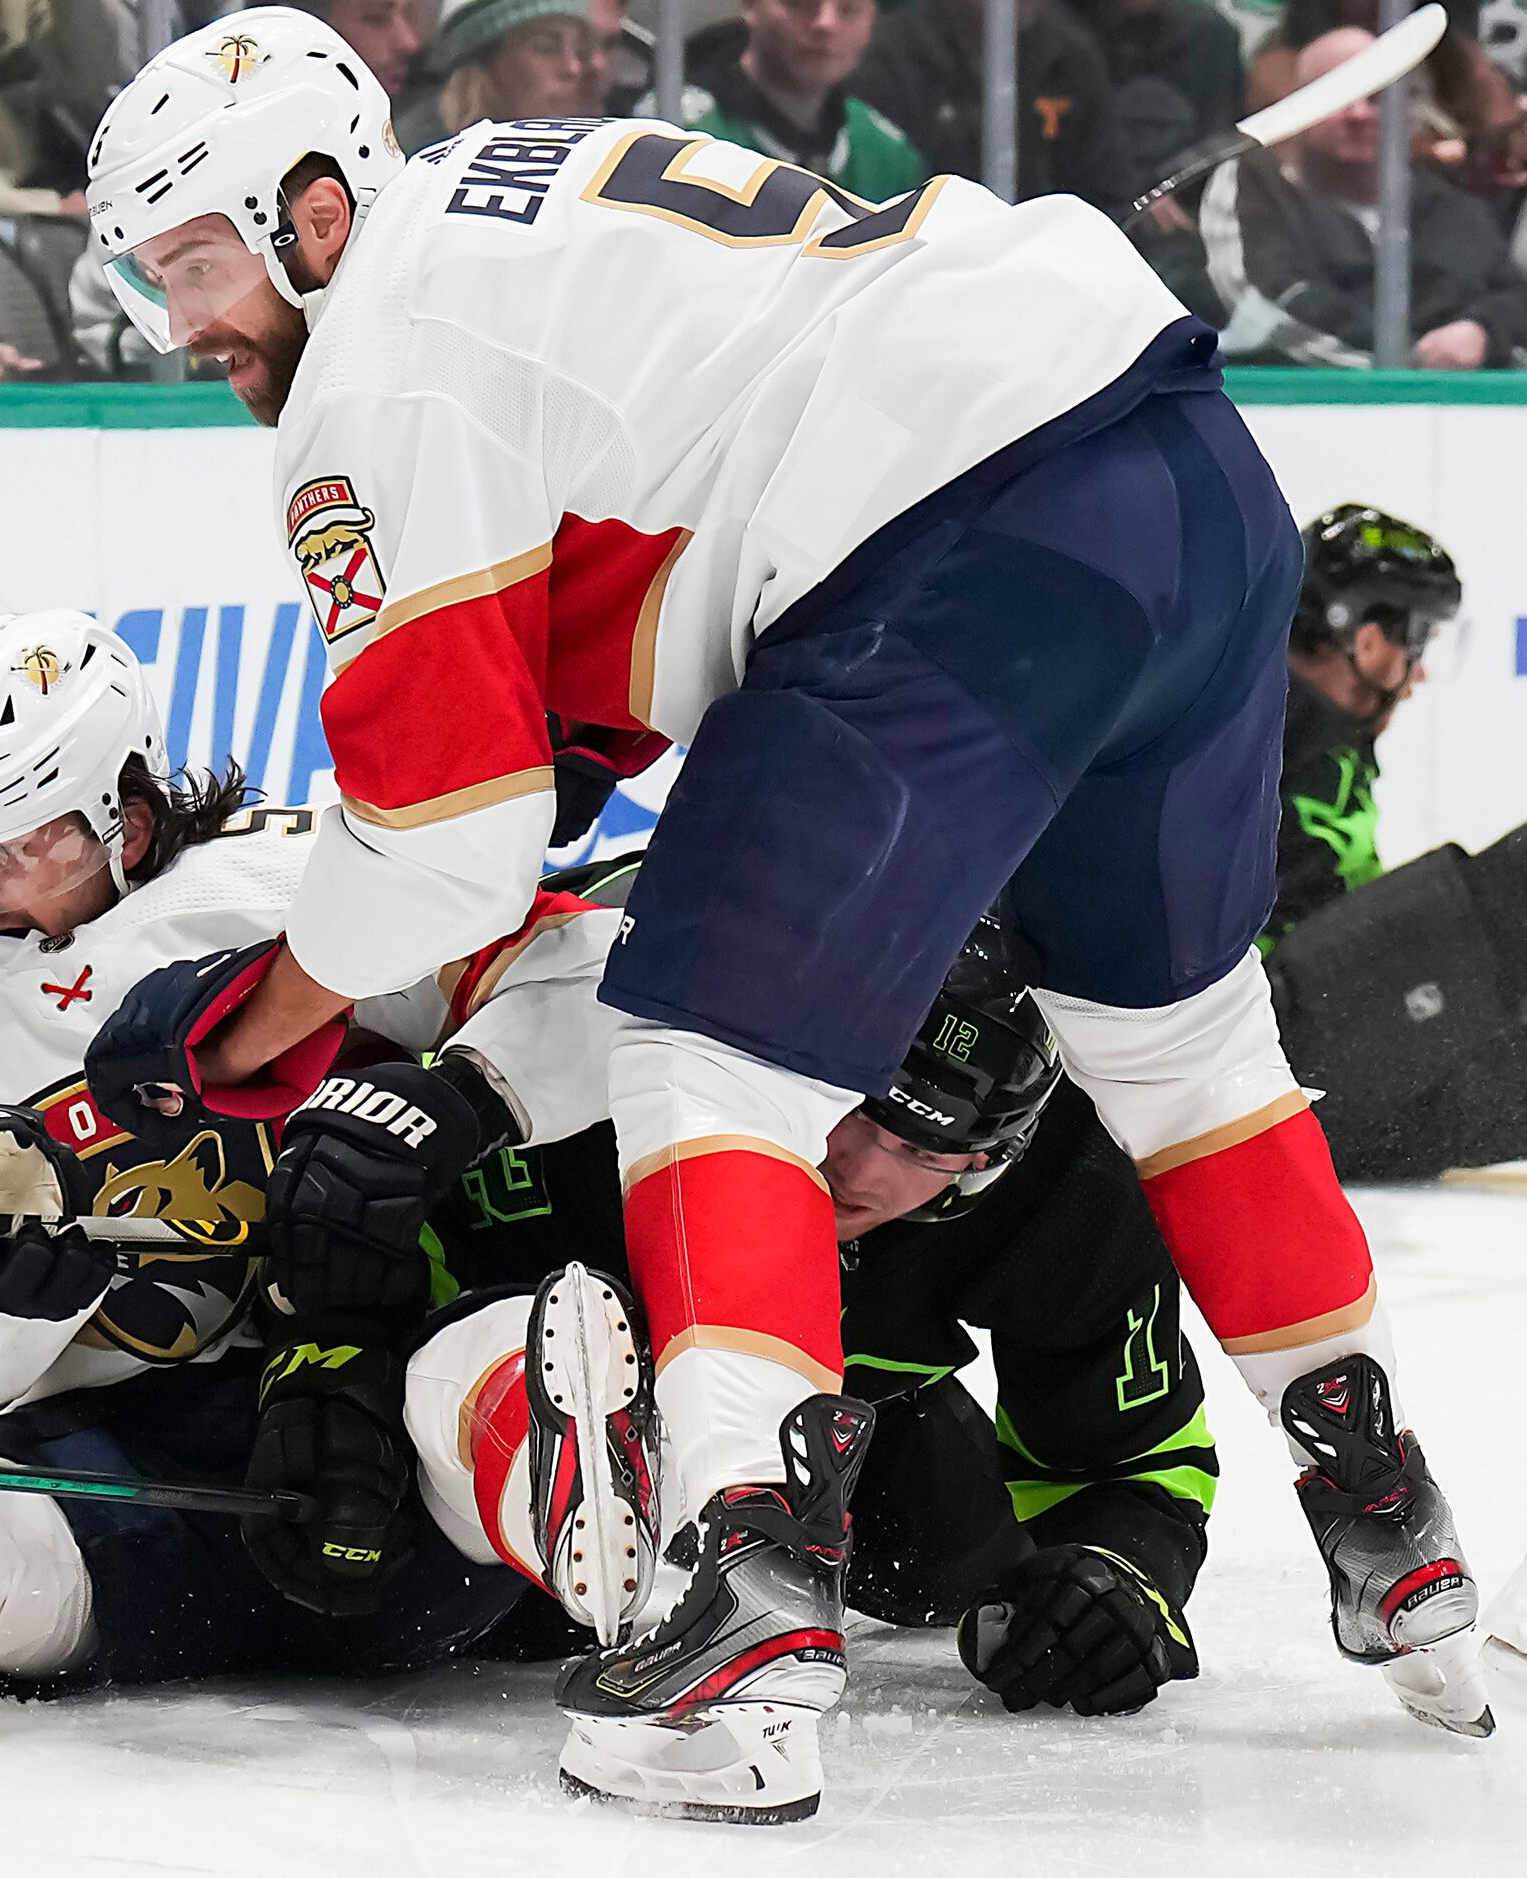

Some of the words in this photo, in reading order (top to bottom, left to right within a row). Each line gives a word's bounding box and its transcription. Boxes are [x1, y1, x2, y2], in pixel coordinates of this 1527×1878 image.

[444, 116, 617, 225] EKBLA
[932, 1013, 980, 1063] 12
[888, 1085, 955, 1127] CCM
[322, 1541, 382, 1562] CCM
[1407, 1576, 1460, 1609] BAUER
